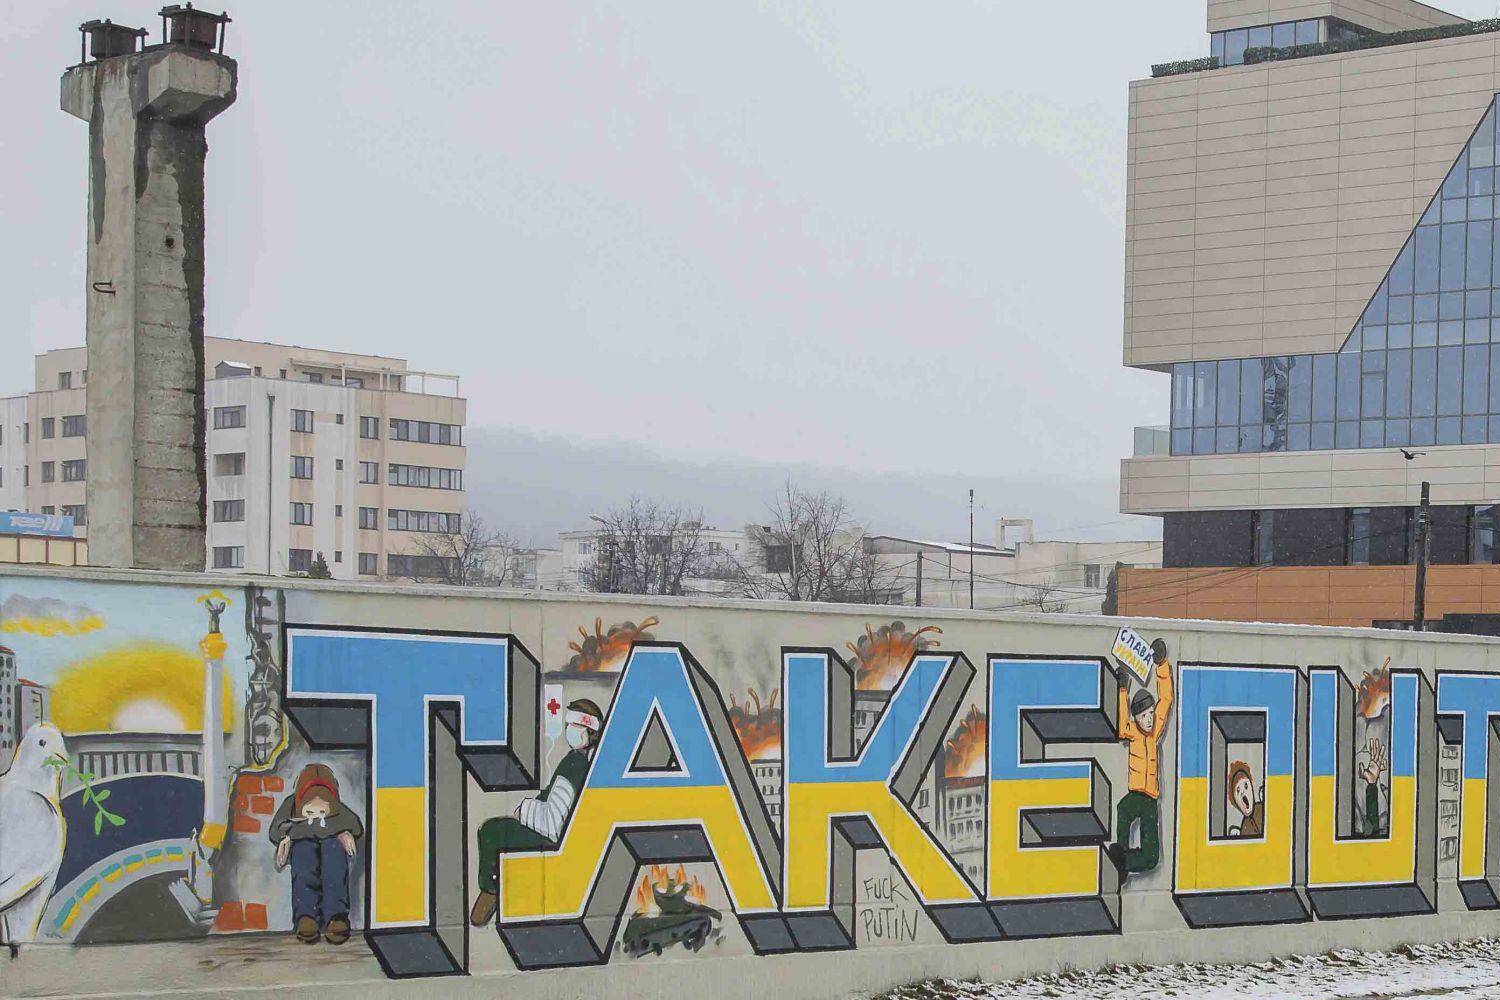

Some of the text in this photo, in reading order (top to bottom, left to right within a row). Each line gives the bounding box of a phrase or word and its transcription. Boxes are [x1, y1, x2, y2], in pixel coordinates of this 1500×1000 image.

[1120, 629, 1153, 666] СЛАВА
[283, 626, 1121, 975] TAKE
[863, 873, 910, 903] FUCK
